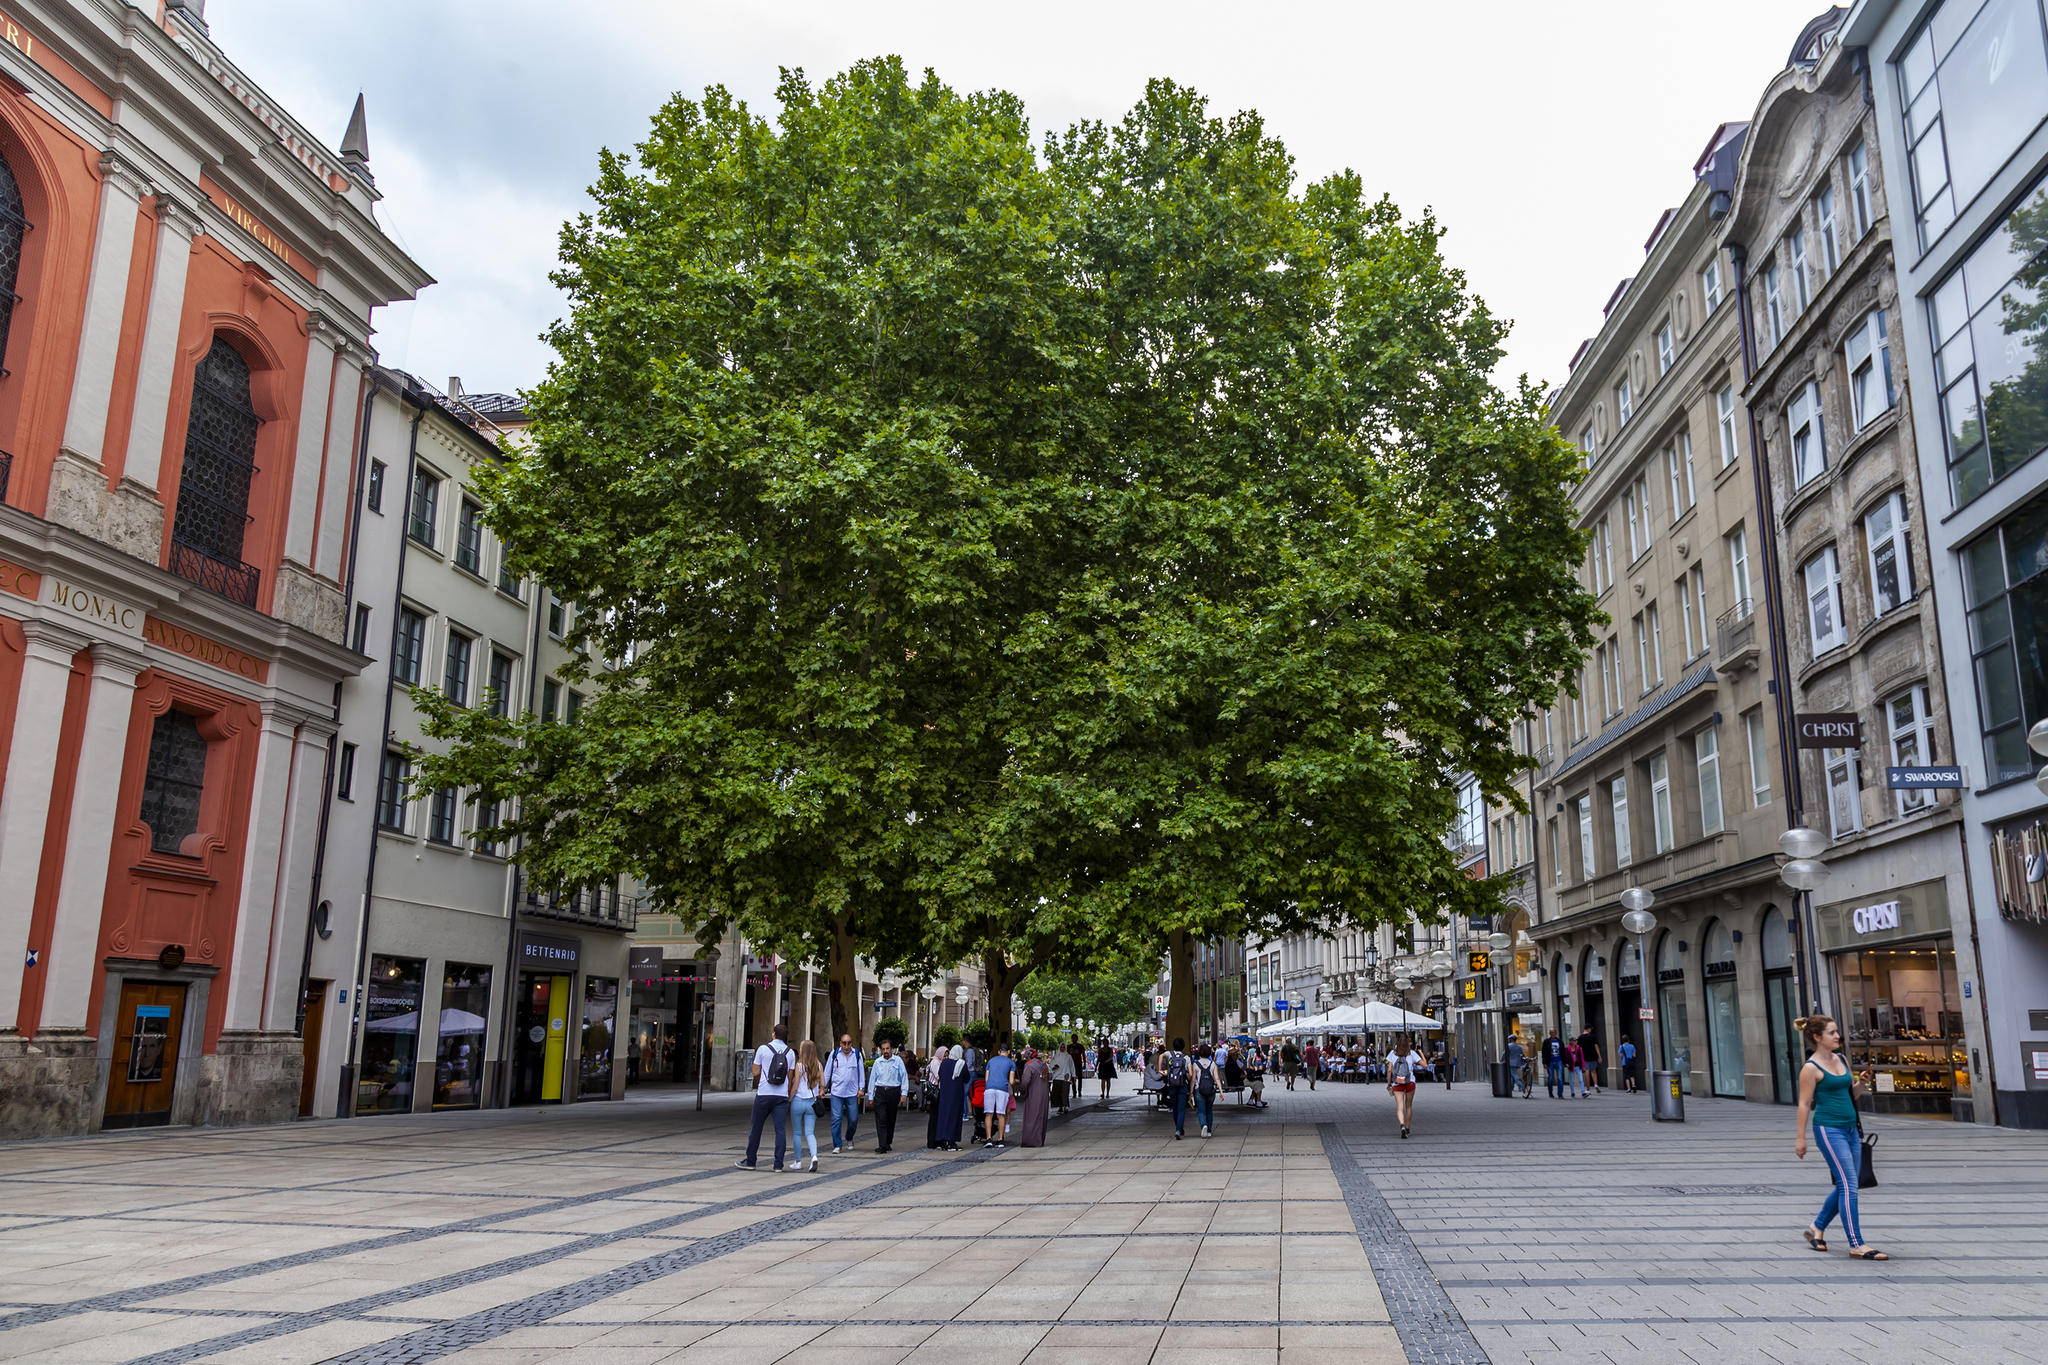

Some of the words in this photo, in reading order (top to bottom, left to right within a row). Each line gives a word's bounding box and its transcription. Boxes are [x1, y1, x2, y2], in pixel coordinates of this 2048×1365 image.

[225, 197, 289, 264] VIRGINI
[1877, 547, 1895, 567] RADO
[52, 580, 137, 630] MONAC
[1802, 722, 1856, 738] CHRIST
[1904, 772, 1959, 783] SWAROVSKI
[1853, 900, 1902, 935] CHRIST
[525, 944, 576, 961] BETTENRID
[1659, 968, 1684, 981] ZARA
[1706, 960, 1736, 975] ZARA
